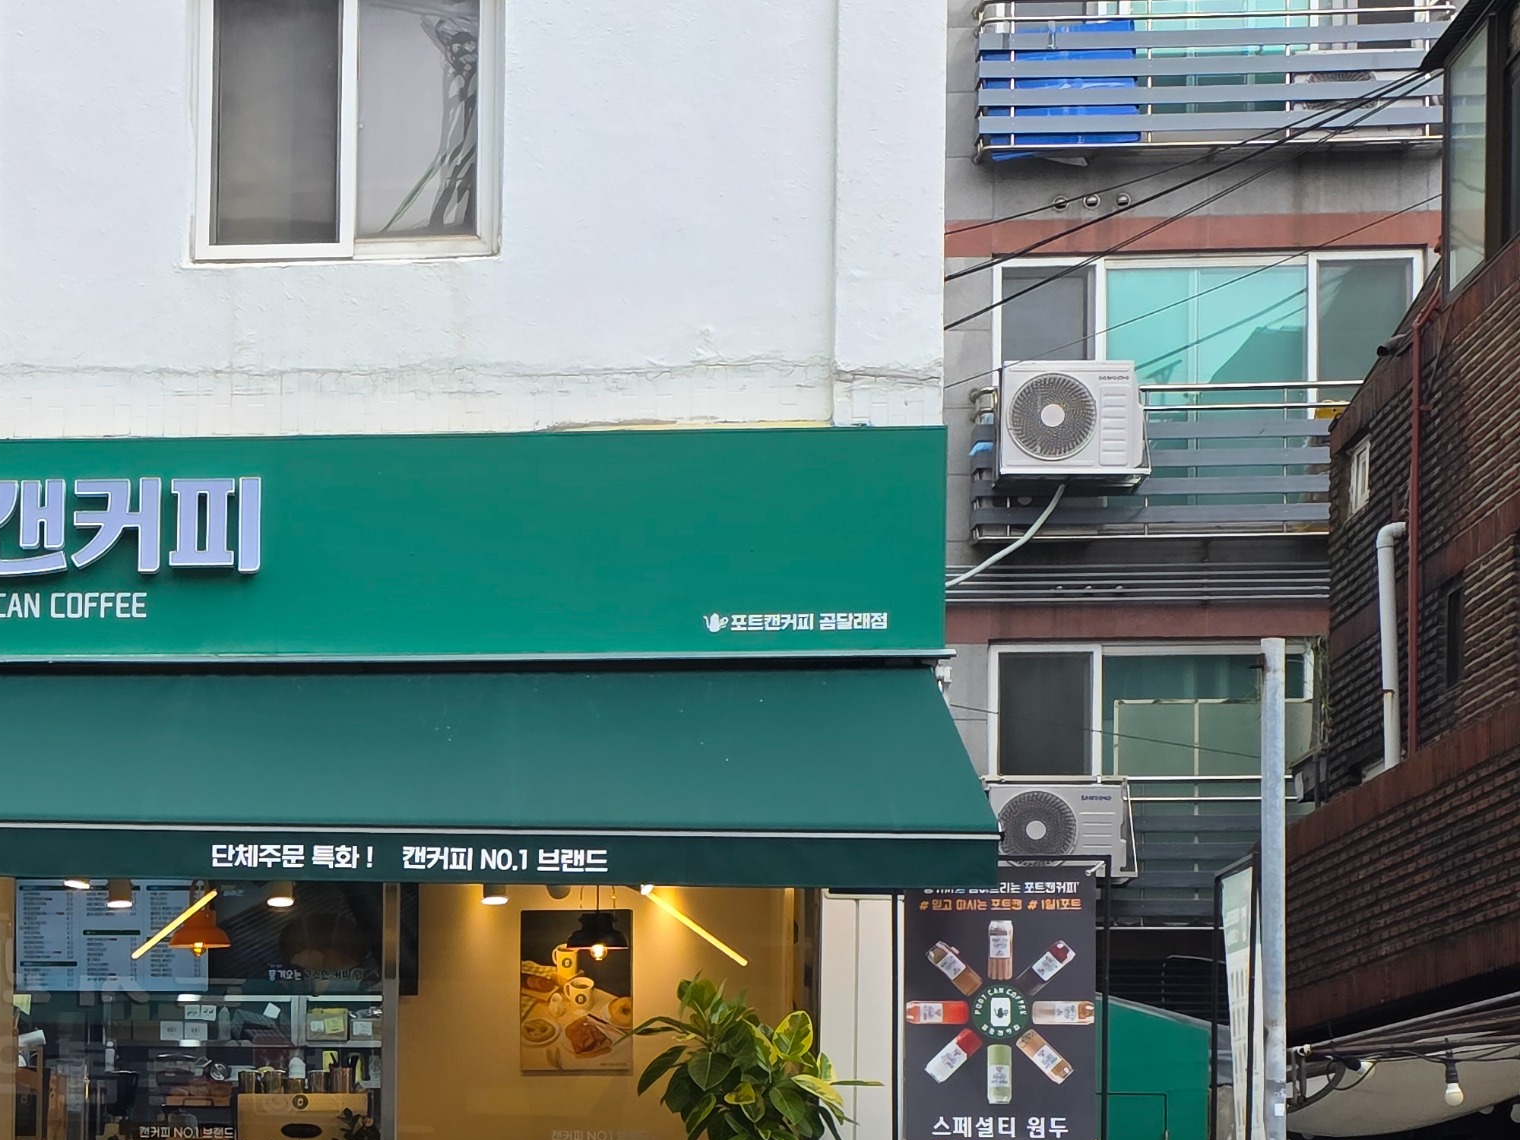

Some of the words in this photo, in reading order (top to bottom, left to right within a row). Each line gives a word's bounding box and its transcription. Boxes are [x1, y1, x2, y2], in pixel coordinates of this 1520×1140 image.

[50, 592, 148, 619] COFFEE
[730, 613, 814, 631] 포트캔커피
[819, 612, 888, 630] 곰달래점
[211, 843, 305, 868] 단체주문
[311, 844, 360, 869] 특화
[402, 846, 473, 871] 캔커피
[480, 848, 528, 871] NO.1
[537, 848, 609, 873] 브랜드
[173, 1126, 199, 1139] NO.1
[202, 1127, 234, 1139] 브랜드
[931, 1117, 1016, 1138] 스페셜티
[1026, 1117, 1069, 1139] 원두
